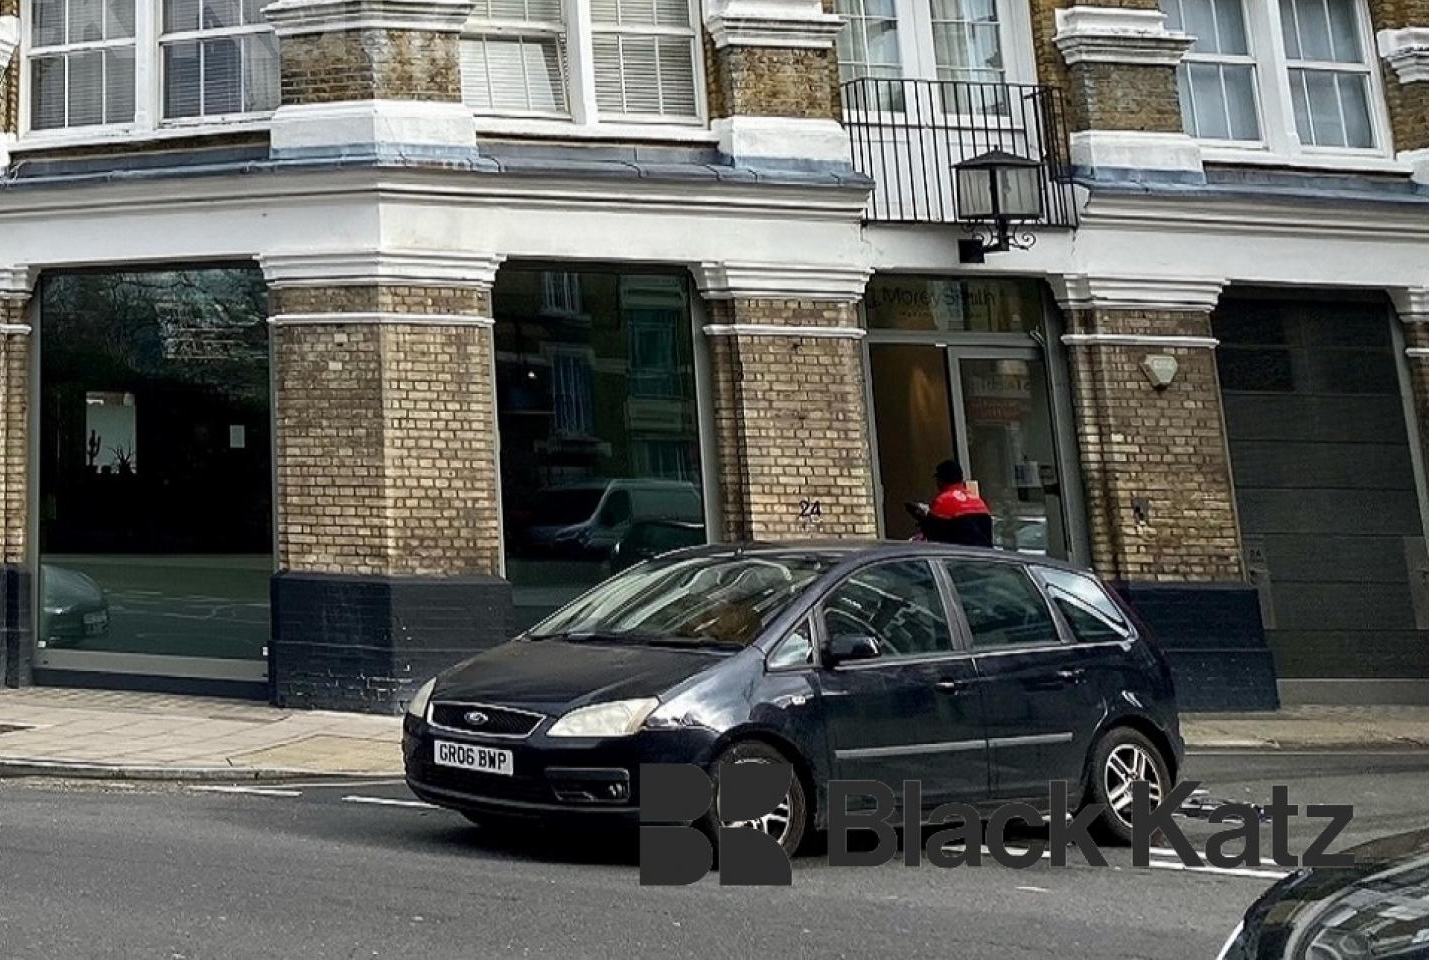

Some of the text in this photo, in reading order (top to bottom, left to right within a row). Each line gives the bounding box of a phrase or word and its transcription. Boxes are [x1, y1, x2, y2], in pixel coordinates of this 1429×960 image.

[799, 500, 821, 517] 24
[439, 743, 507, 771] GR06 BWP
